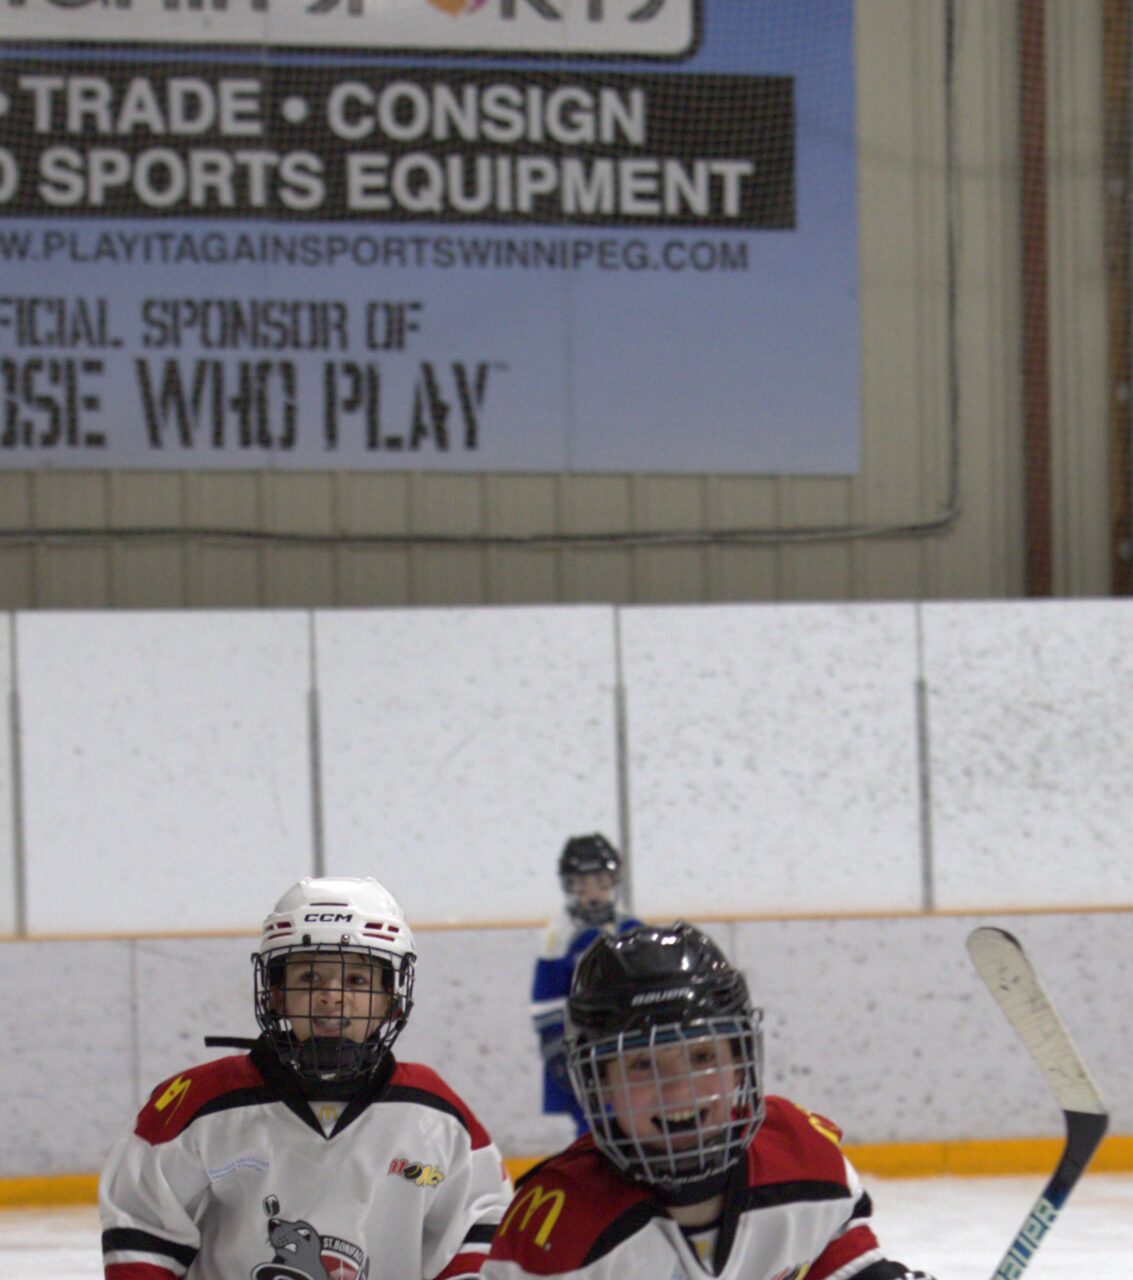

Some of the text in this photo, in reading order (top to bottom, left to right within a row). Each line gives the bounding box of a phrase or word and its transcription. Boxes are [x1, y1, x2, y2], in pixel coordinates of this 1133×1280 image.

[20, 76, 646, 145] TRADE CONSIGN
[38, 147, 326, 210] SPORTS
[346, 151, 755, 217] EQUIPMENT
[142, 298, 348, 351] SPONSOR
[366, 302, 422, 351] OF
[134, 357, 298, 450] WHO
[303, 913, 353, 923] CCM
